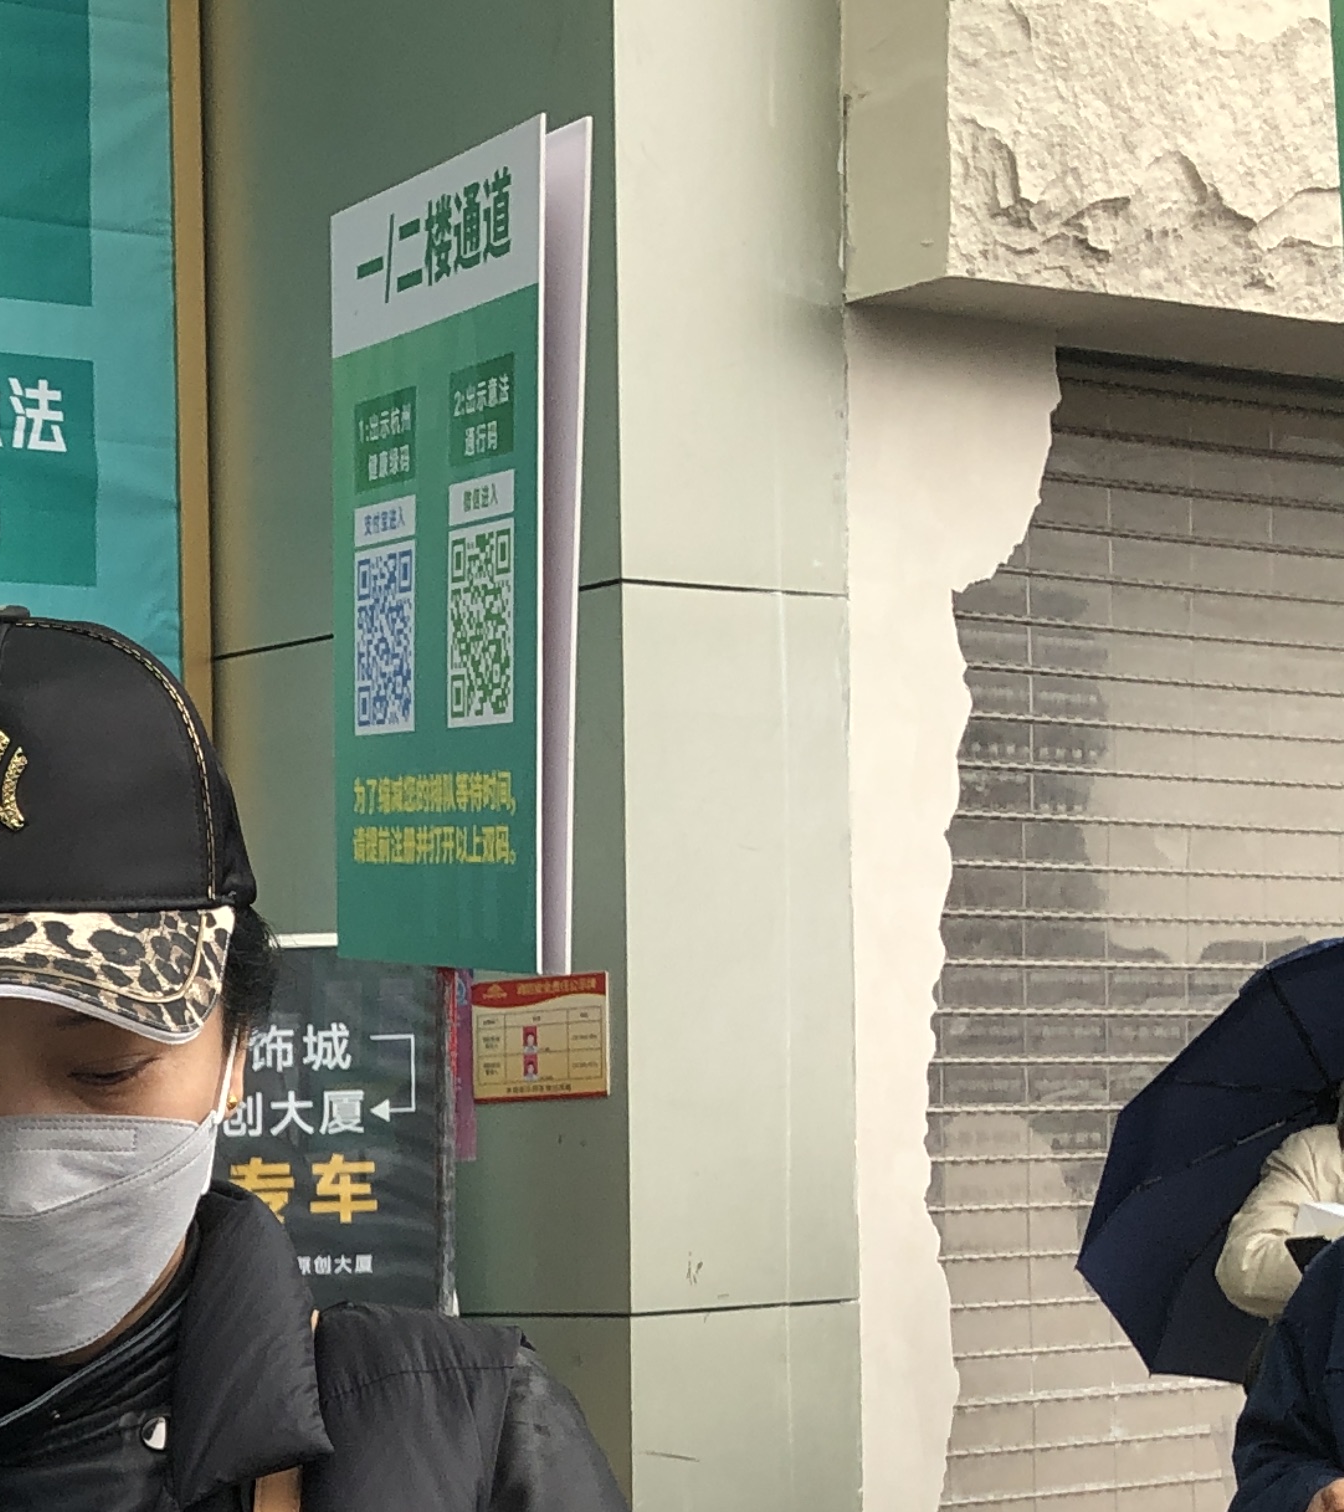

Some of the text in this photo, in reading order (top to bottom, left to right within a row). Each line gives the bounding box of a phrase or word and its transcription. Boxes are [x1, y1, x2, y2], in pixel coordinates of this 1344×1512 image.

[356, 166, 512, 304] 一/二楼通道
